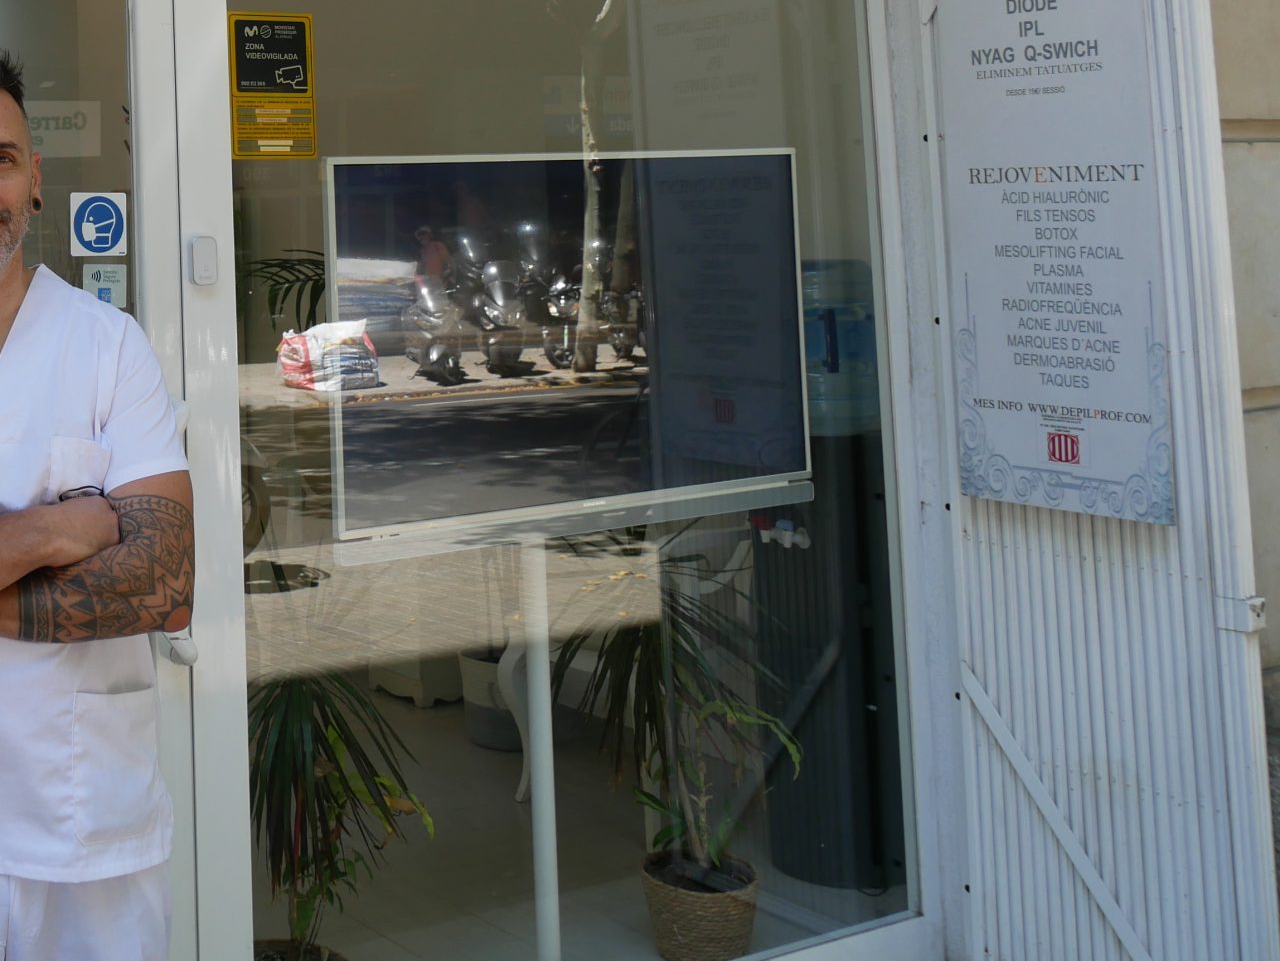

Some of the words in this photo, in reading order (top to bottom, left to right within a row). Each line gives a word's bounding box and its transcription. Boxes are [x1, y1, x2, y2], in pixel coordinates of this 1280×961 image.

[1018, 20, 1045, 38] IPL
[245, 52, 298, 60] VIDEOVIGILADA
[971, 47, 1015, 66] NYAG
[1024, 39, 1098, 62] Q-SWICH
[976, 67, 1032, 80] ELIMINEM
[1034, 62, 1103, 76] TATUATGES
[968, 164, 1145, 185] REJOVENIMENT
[1016, 209, 1042, 222] FILS
[1044, 209, 1096, 222] TENSOS
[1035, 227, 1078, 240] BOTOX
[994, 245, 1076, 259] MESOLIFTING
[1080, 246, 1124, 260] FACIAL
[1034, 264, 1084, 278] PLASMA
[1026, 281, 1093, 296] VITAMINES
[1017, 318, 1051, 331] ACNE
[1055, 319, 1107, 334] JUVENIL
[1007, 335, 1068, 350] MARQUES
[1039, 372, 1089, 388] TAQUES
[973, 398, 995, 409] MES
[997, 400, 1023, 412] INFO
